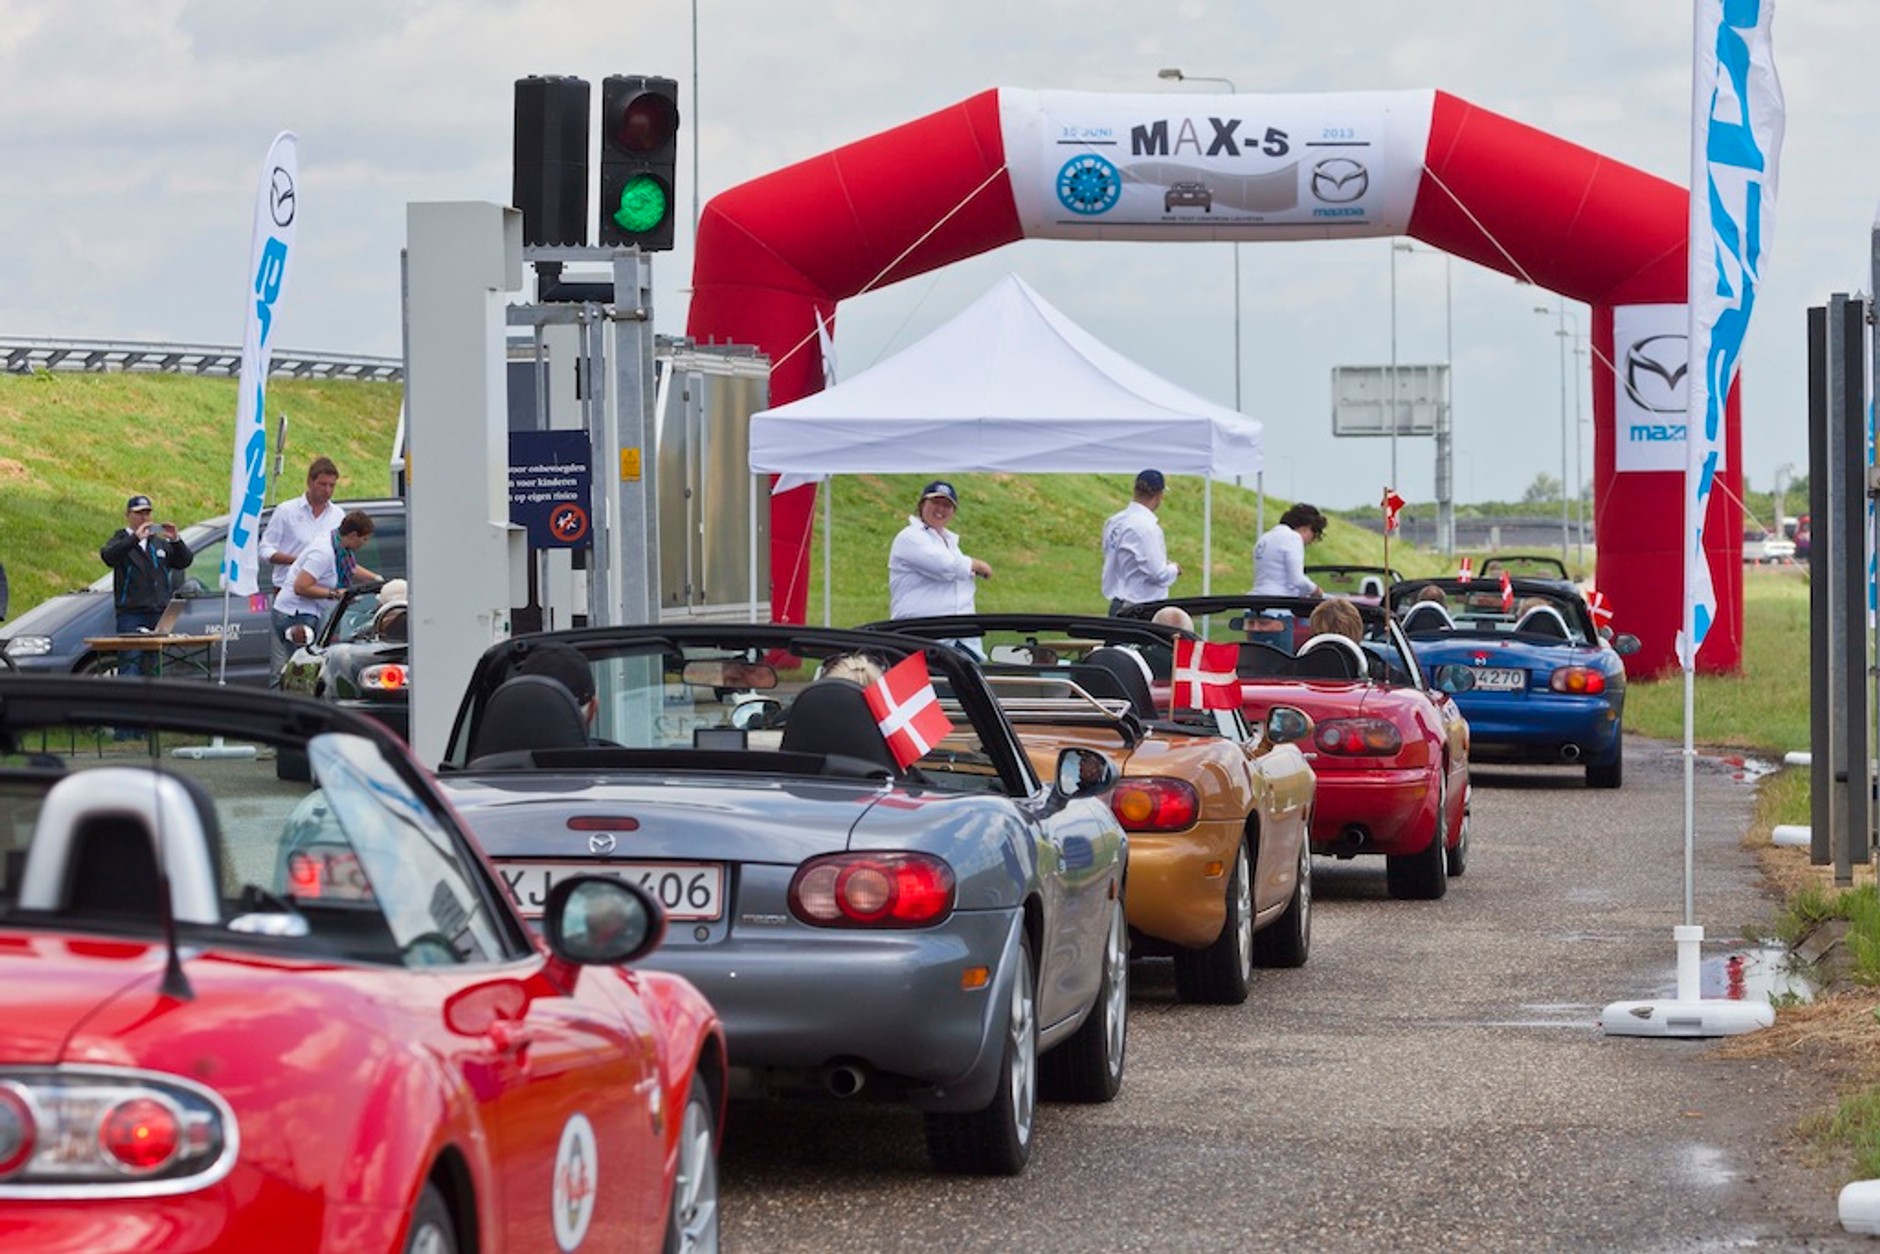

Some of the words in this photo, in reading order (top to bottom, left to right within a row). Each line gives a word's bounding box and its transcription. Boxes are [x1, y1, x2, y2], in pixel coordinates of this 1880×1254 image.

[1130, 117, 1290, 157] MAX-5
[1630, 425, 1687, 441] maz
[528, 464, 586, 474] onbevoegden
[516, 479, 537, 487] voor
[537, 477, 577, 486] kinderen
[514, 494, 526, 503] op
[527, 492, 552, 503] eigen
[553, 491, 578, 500] risico
